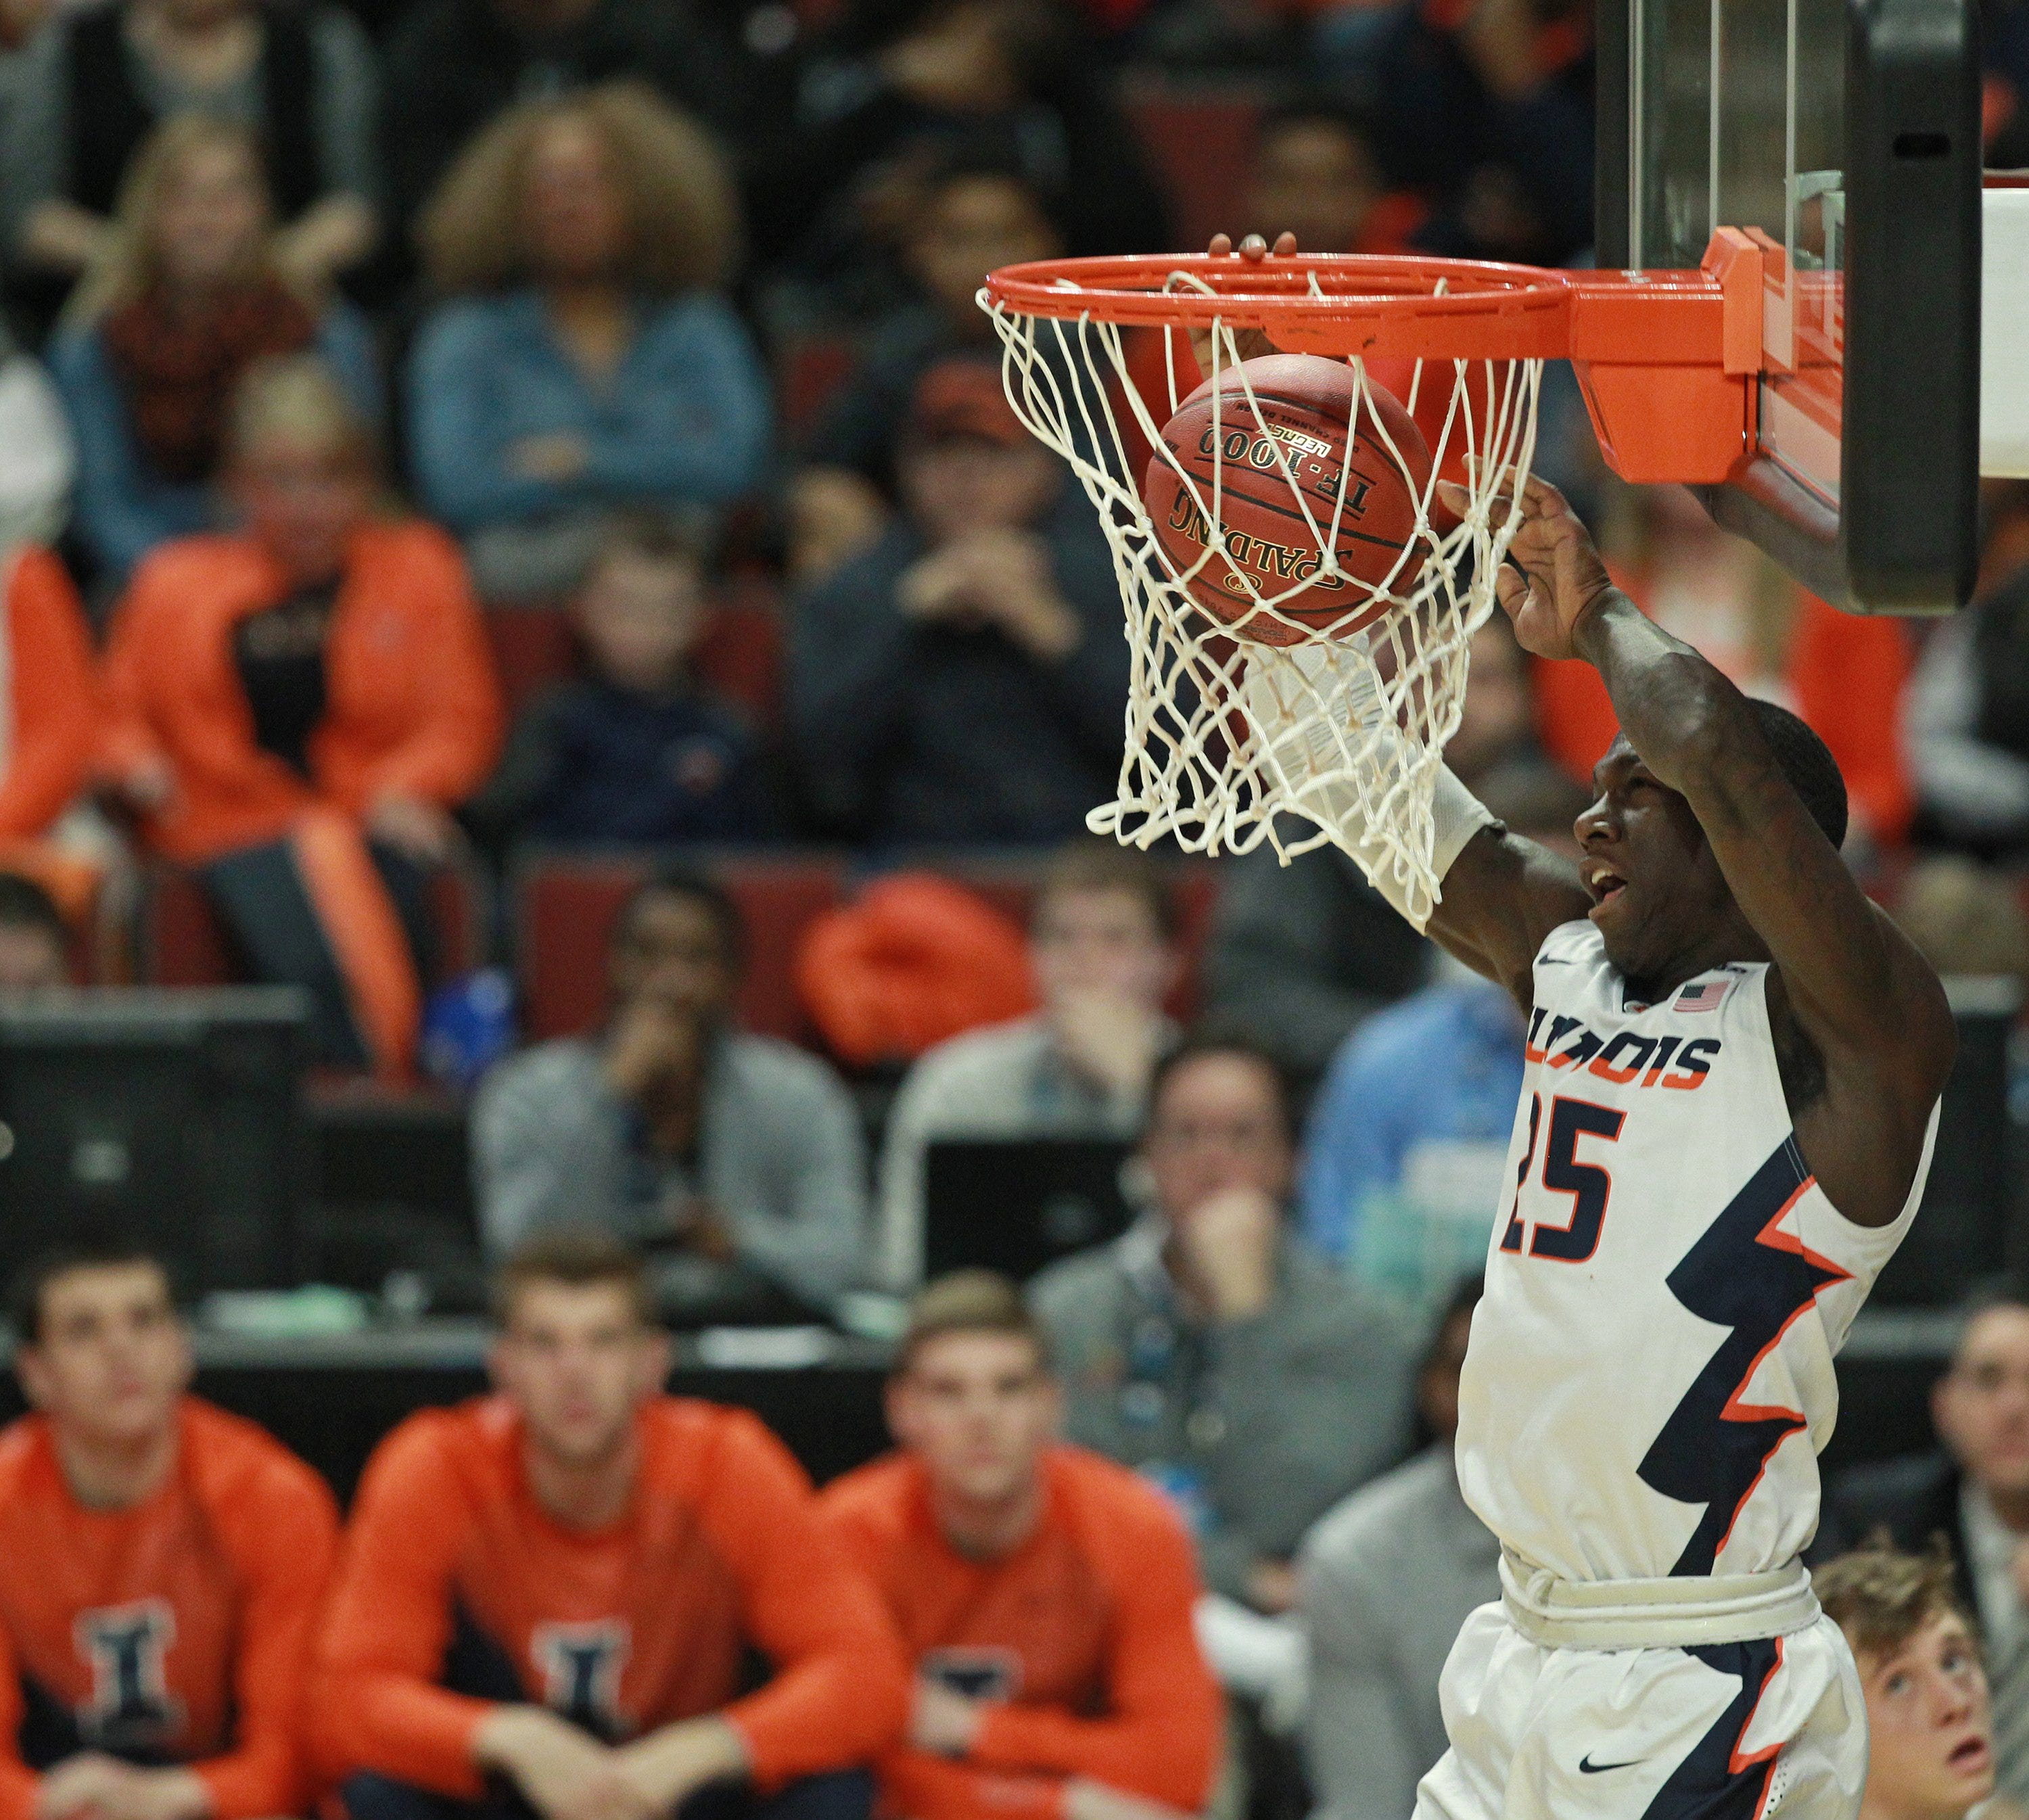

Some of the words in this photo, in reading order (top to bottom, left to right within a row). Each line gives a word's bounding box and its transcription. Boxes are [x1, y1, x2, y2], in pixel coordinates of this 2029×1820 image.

[1236, 403, 1278, 421] DEGN
[1280, 413, 1330, 438] CHANNEL
[1198, 426, 1371, 514] TF-1000
